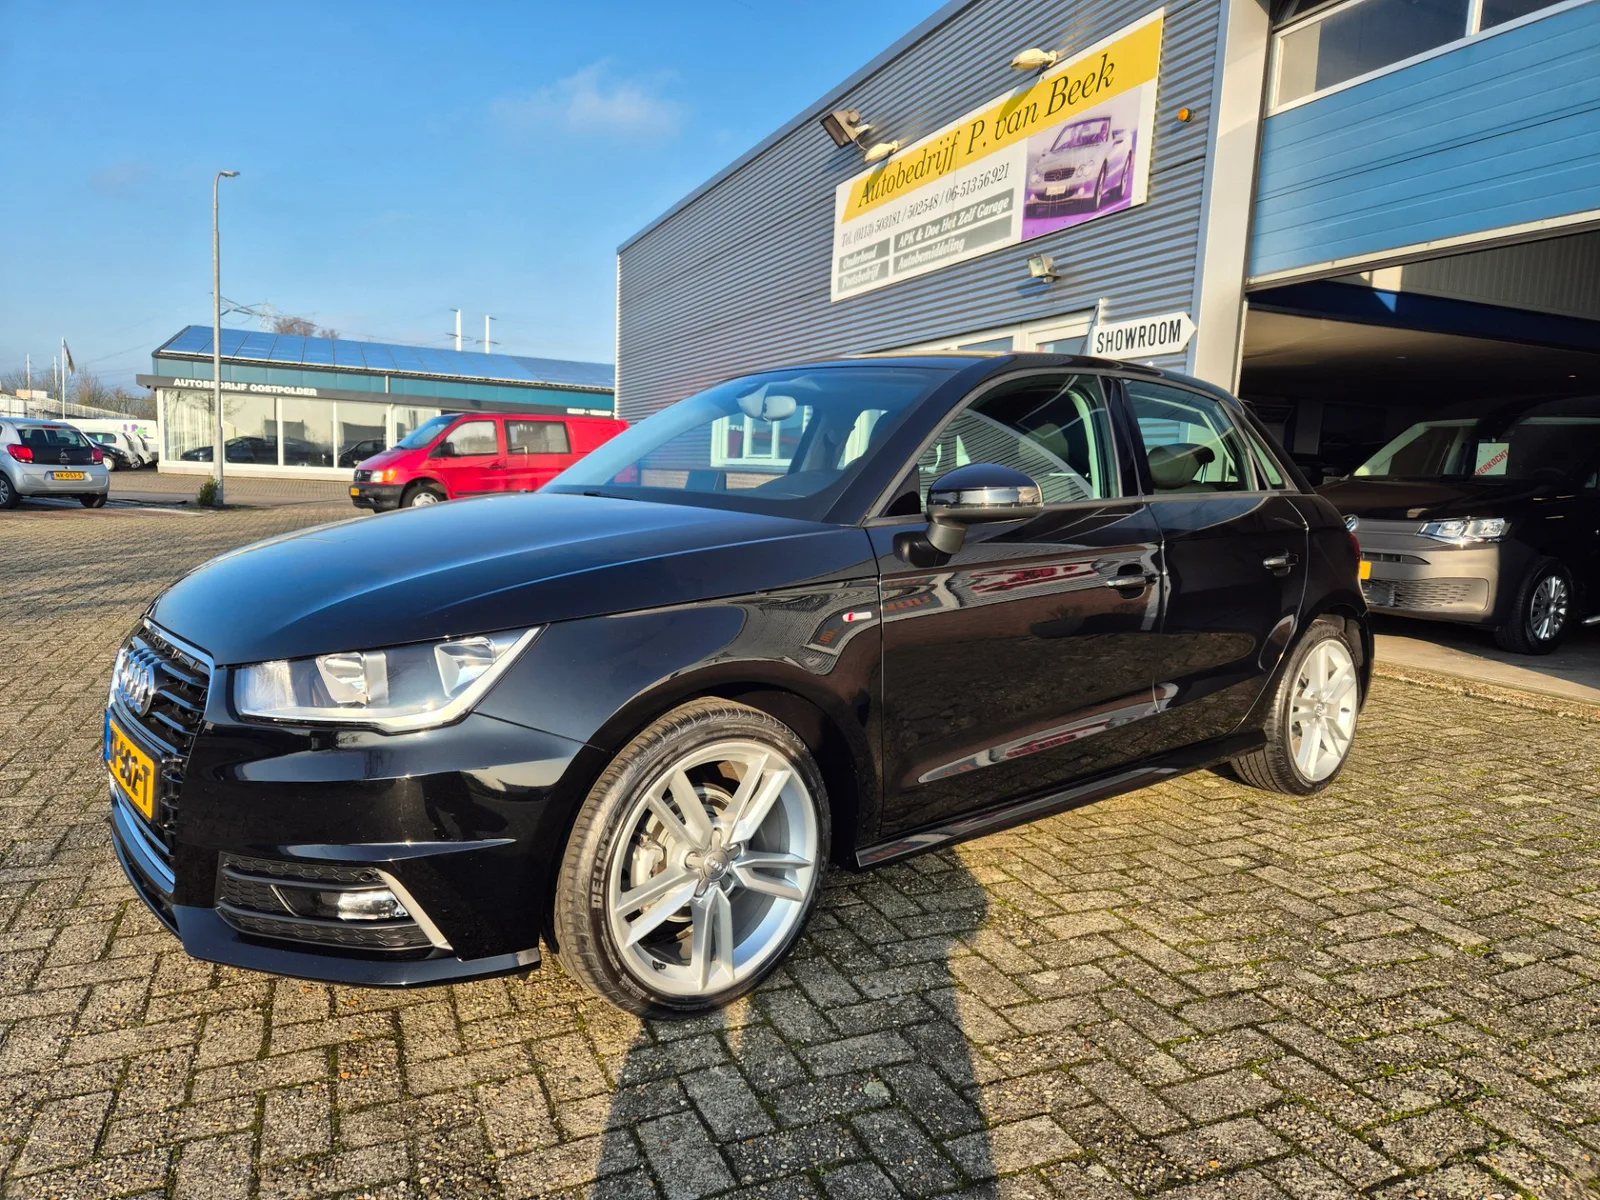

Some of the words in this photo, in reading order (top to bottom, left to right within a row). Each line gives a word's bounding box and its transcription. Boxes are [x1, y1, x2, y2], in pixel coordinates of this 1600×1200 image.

[858, 131, 960, 208] Autobedrijf
[965, 119, 986, 155] P.
[995, 99, 1039, 140] van
[1044, 52, 1115, 118] Beek
[898, 230, 916, 248] APK
[915, 228, 923, 241] &
[924, 224, 939, 239] Doe
[941, 216, 957, 232] Het
[957, 205, 976, 226] Zelf
[977, 197, 1010, 218] Garage
[907, 193, 939, 221] 502548
[1096, 318, 1182, 354] SHOWROOM
[249, 383, 317, 396] OOSTPOLDER
